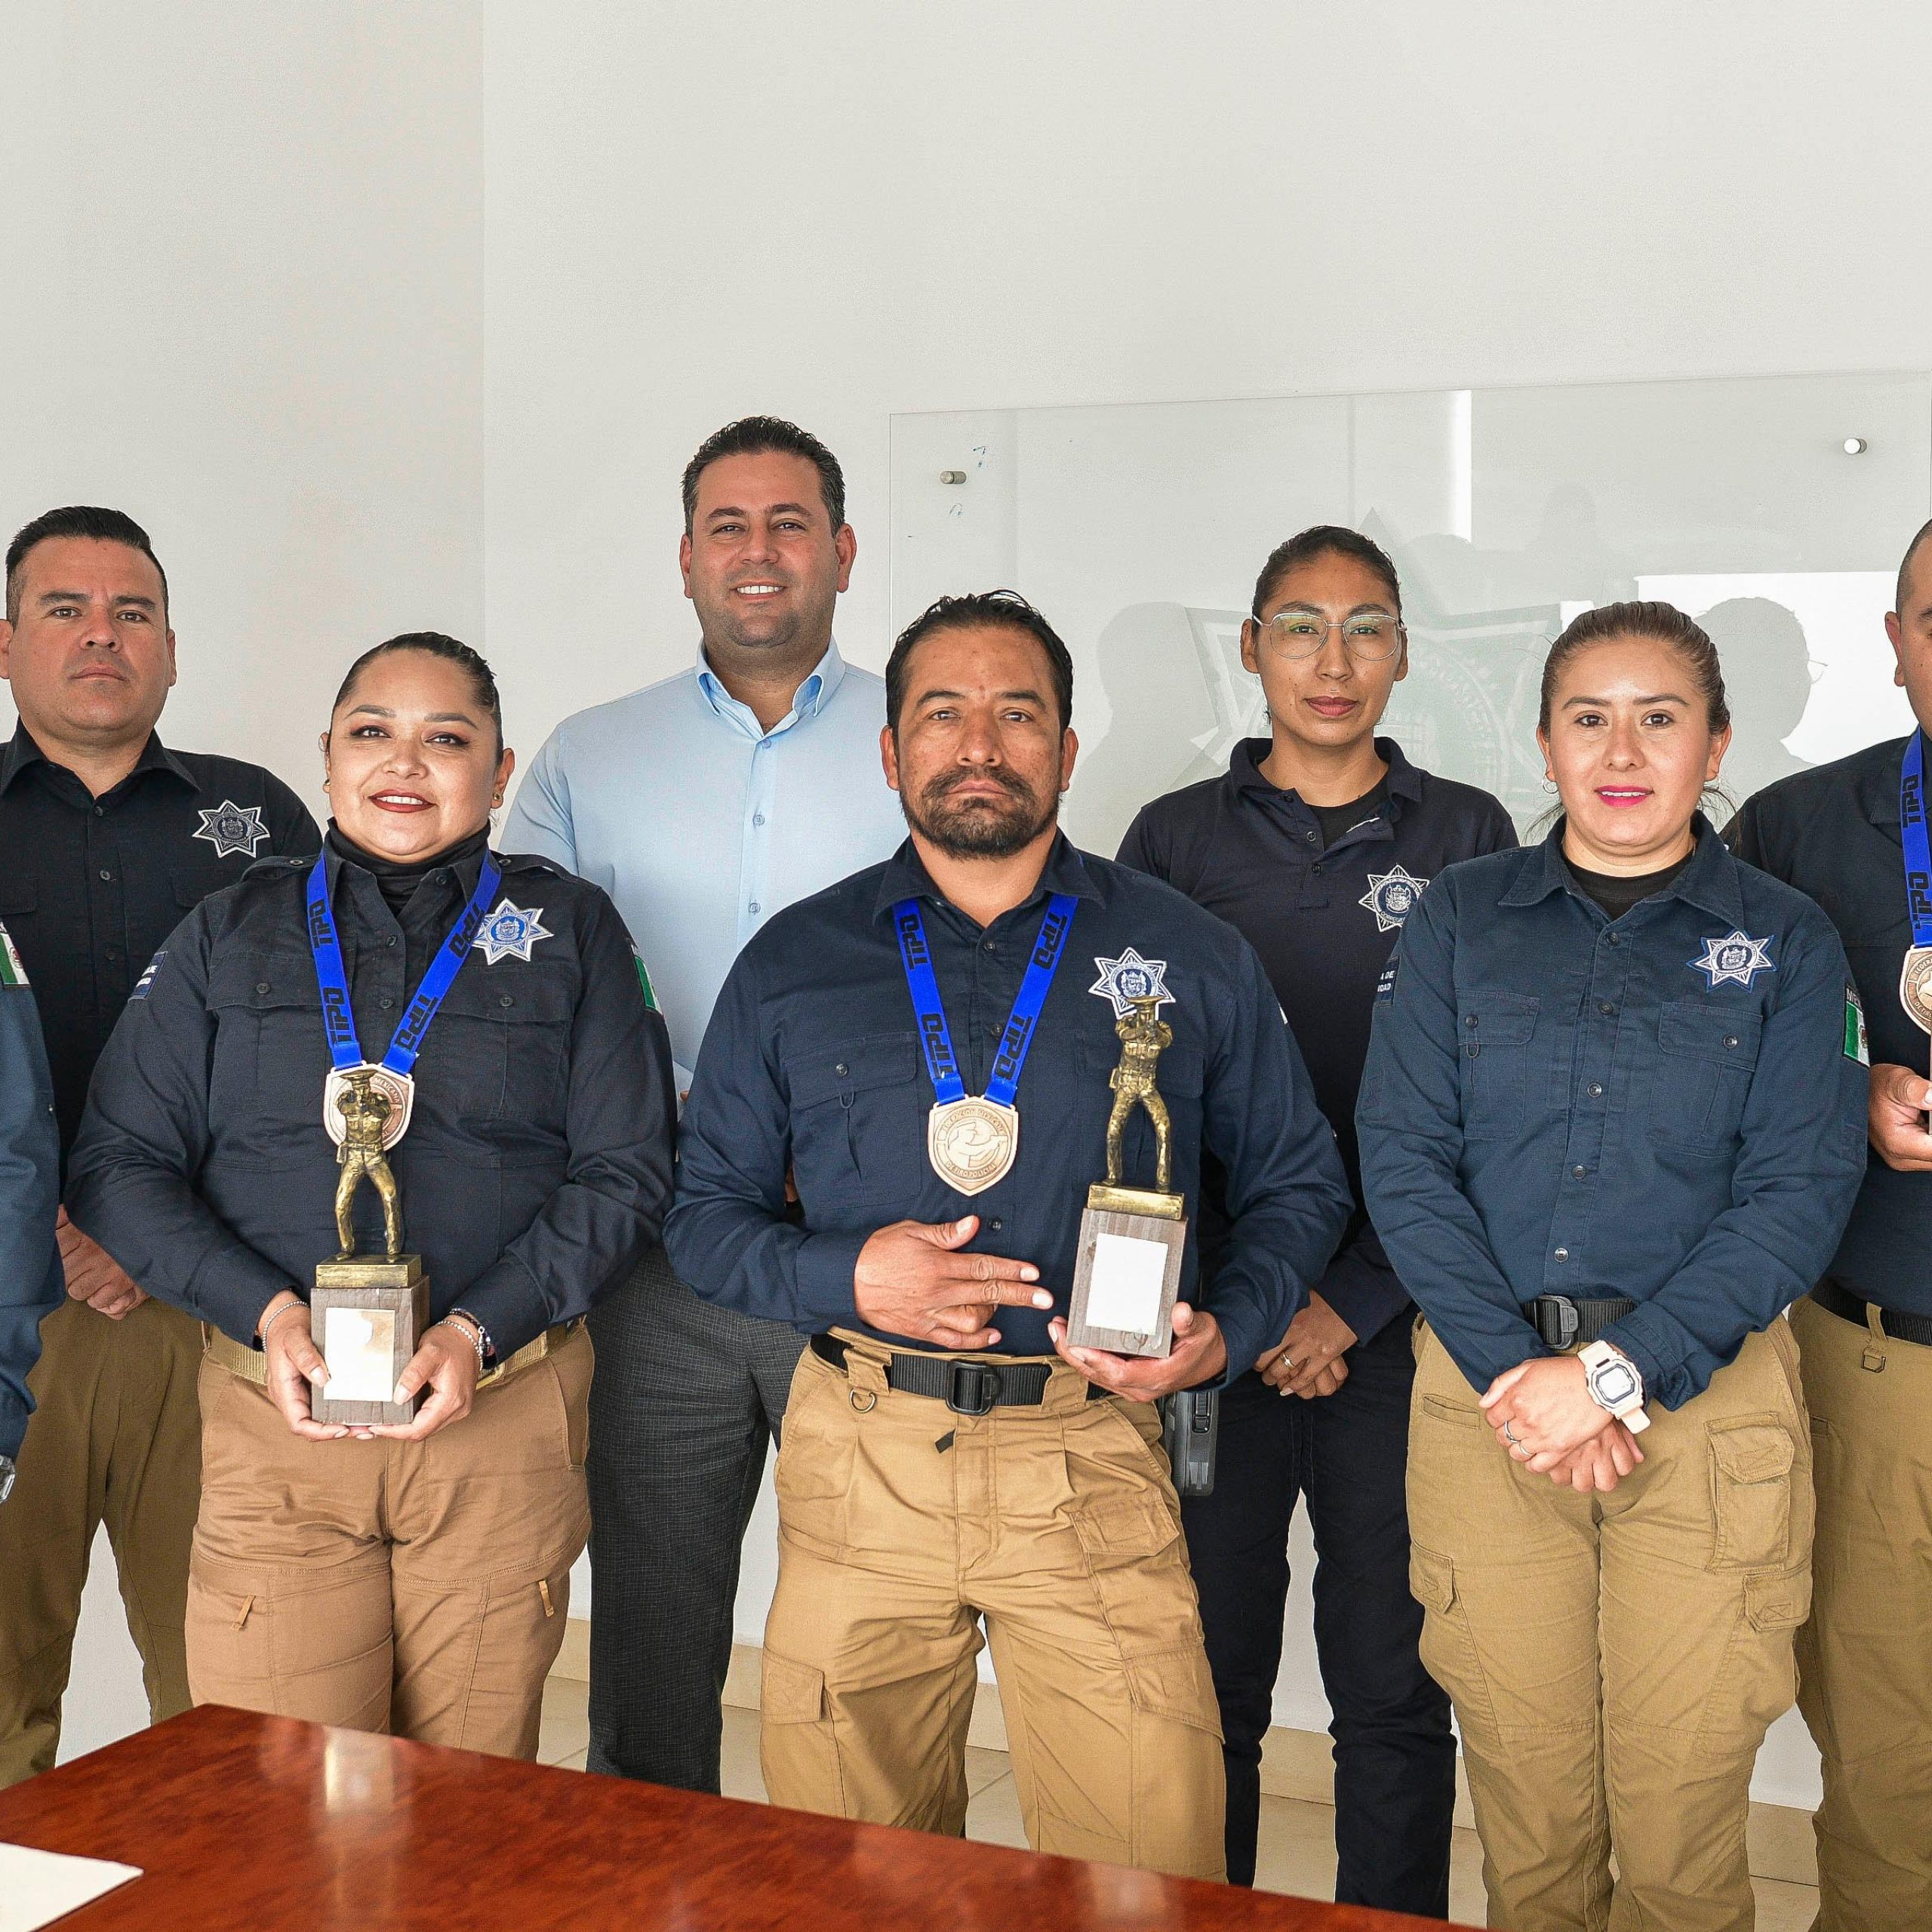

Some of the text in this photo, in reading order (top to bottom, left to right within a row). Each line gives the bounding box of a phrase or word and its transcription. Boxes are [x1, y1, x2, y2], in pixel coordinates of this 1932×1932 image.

[1902, 774, 1922, 829] TIPO
[309, 900, 332, 949] TIPO
[899, 915, 929, 971] TIPO
[1032, 912, 1069, 971] TIPO
[994, 1014, 1033, 1081] TIPO
